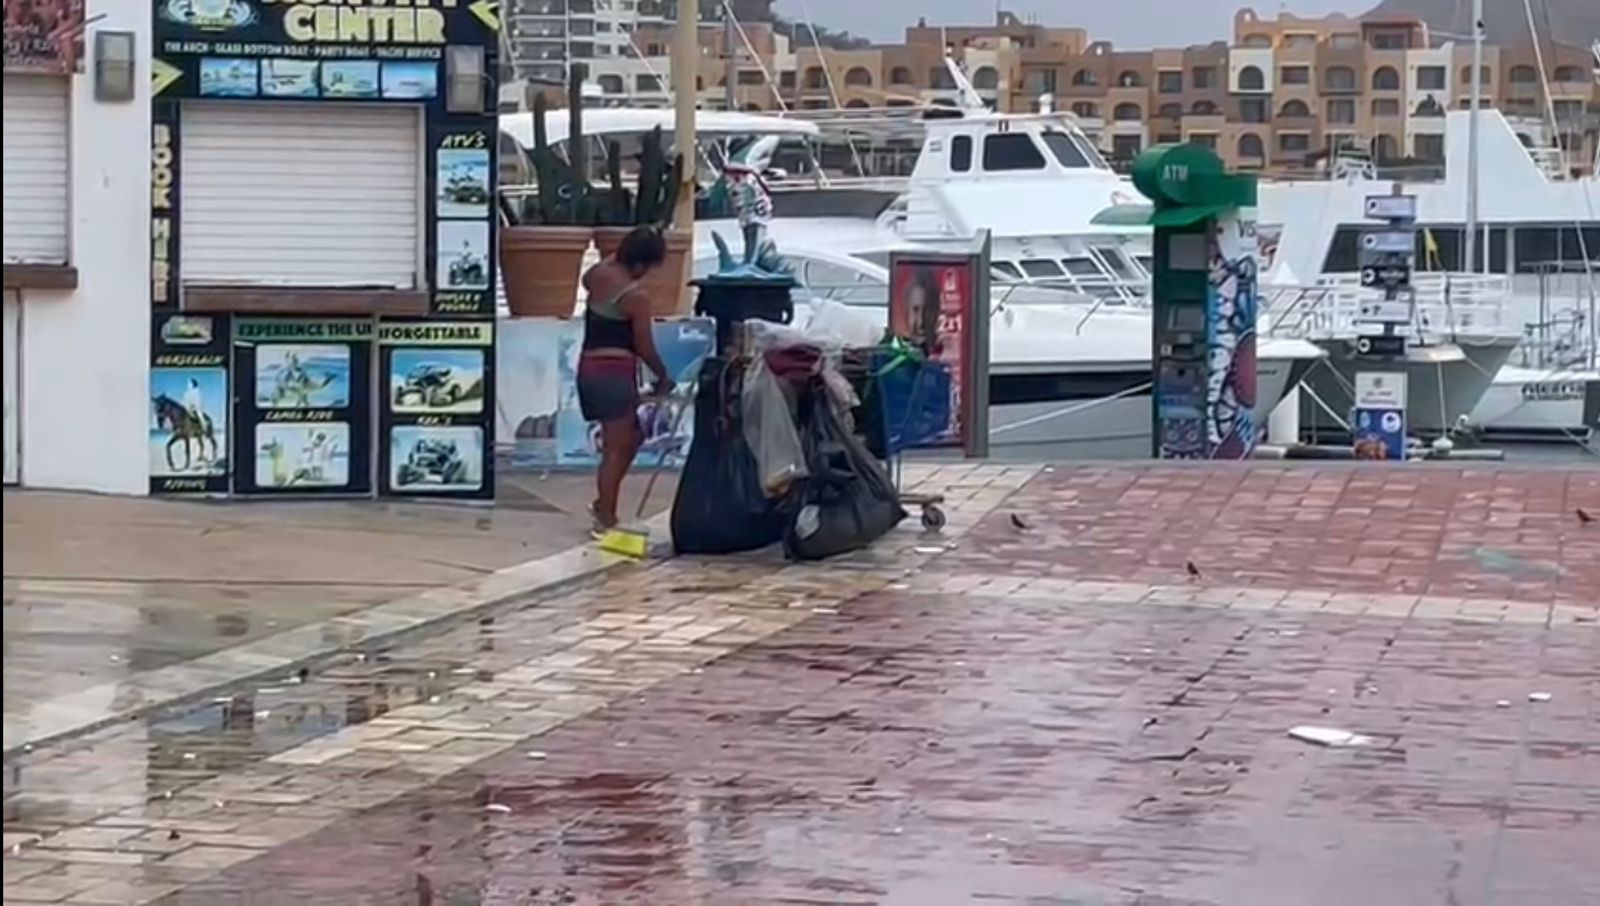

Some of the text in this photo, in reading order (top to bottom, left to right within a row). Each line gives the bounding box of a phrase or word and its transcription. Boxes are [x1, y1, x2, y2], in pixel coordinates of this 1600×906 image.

[283, 5, 446, 42] CENTER
[183, 41, 209, 53] ARCH
[152, 123, 172, 209] BOOK
[238, 322, 323, 338] EXPERIENCE
[326, 323, 352, 336] THE
